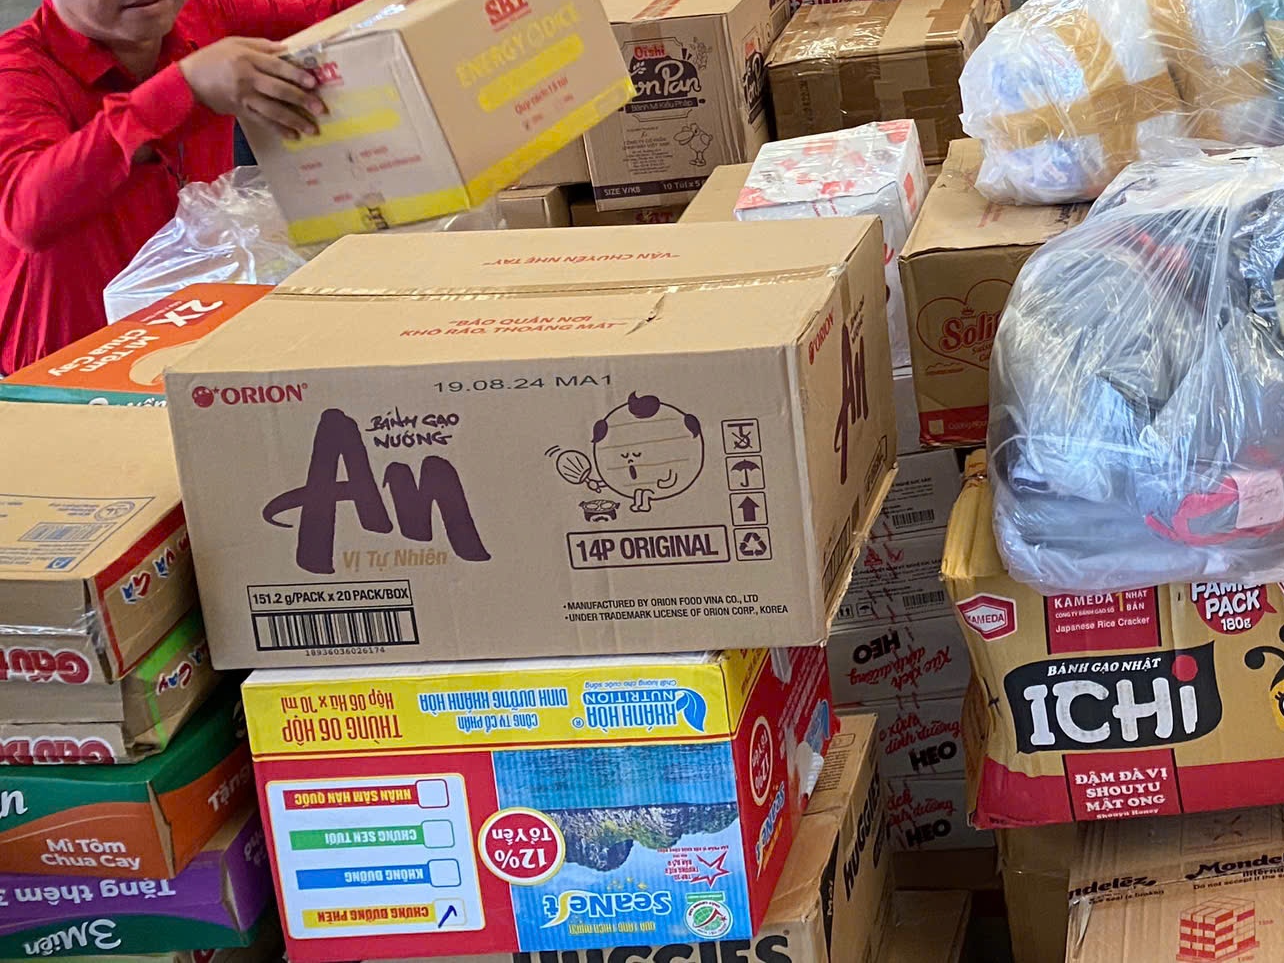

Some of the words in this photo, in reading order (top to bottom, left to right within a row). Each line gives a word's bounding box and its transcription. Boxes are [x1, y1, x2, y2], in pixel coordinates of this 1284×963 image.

[633, 44, 665, 60] Oishi
[654, 60, 700, 97] Pan
[604, 187, 620, 195] SIZE
[145, 299, 223, 328] 2X
[433, 378, 545, 393] 19.08.24
[555, 375, 613, 387] MA1
[219, 383, 305, 405] ORION
[262, 408, 492, 575] An
[576, 538, 615, 563] 14P
[620, 533, 719, 560] ORIGINAL
[342, 550, 360, 573] Vị
[366, 549, 388, 572] Tự
[394, 548, 448, 566] Nhiên
[252, 592, 284, 605] 151.2
[285, 590, 325, 605] g/PACK
[336, 590, 351, 602] 20
[352, 587, 410, 602] PACK/BOX
[567, 598, 635, 610] MANUFACTURED
[637, 599, 649, 608] BY
[651, 597, 677, 607] ORION
[679, 596, 702, 606] FOOD
[703, 595, 724, 605] VINA
[744, 594, 758, 603] LTD
[1054, 594, 1114, 609] KAMEDA
[1204, 589, 1261, 619] PACK
[569, 612, 598, 622] UNDER
[600, 610, 652, 620] TRADEMARK
[653, 608, 688, 618] LICENSE
[690, 608, 701, 617] OF
[703, 607, 730, 616] ORION
[760, 604, 788, 614] KOREA
[1055, 621, 1095, 633] Japanese
[1097, 619, 1116, 629] Rice
[1117, 616, 1150, 627] Cracker
[1220, 616, 1251, 632] 180g
[853, 629, 900, 665] HEO
[1091, 662, 1119, 675] GẠO
[281, 696, 299, 713] ml
[541, 688, 568, 708] DINH
[585, 689, 675, 703] NUTRITION
[498, 713, 511, 729] TY
[622, 703, 678, 733] KHÁNH
[321, 717, 341, 741] 06
[908, 740, 957, 772] HEO
[1086, 782, 1161, 799] SHOUYU
[1127, 794, 1166, 807] ONG
[353, 830, 377, 842] SEN
[905, 818, 952, 847] HEO
[46, 838, 80, 853] Mì
[83, 837, 127, 854] Tôm
[40, 854, 98, 868] Chua
[100, 855, 141, 871] Cay
[495, 848, 546, 870] 12%
[15, 884, 94, 907] thêm
[102, 877, 176, 900] Tặng
[23, 921, 88, 956] Miền
[88, 918, 122, 950] 3
